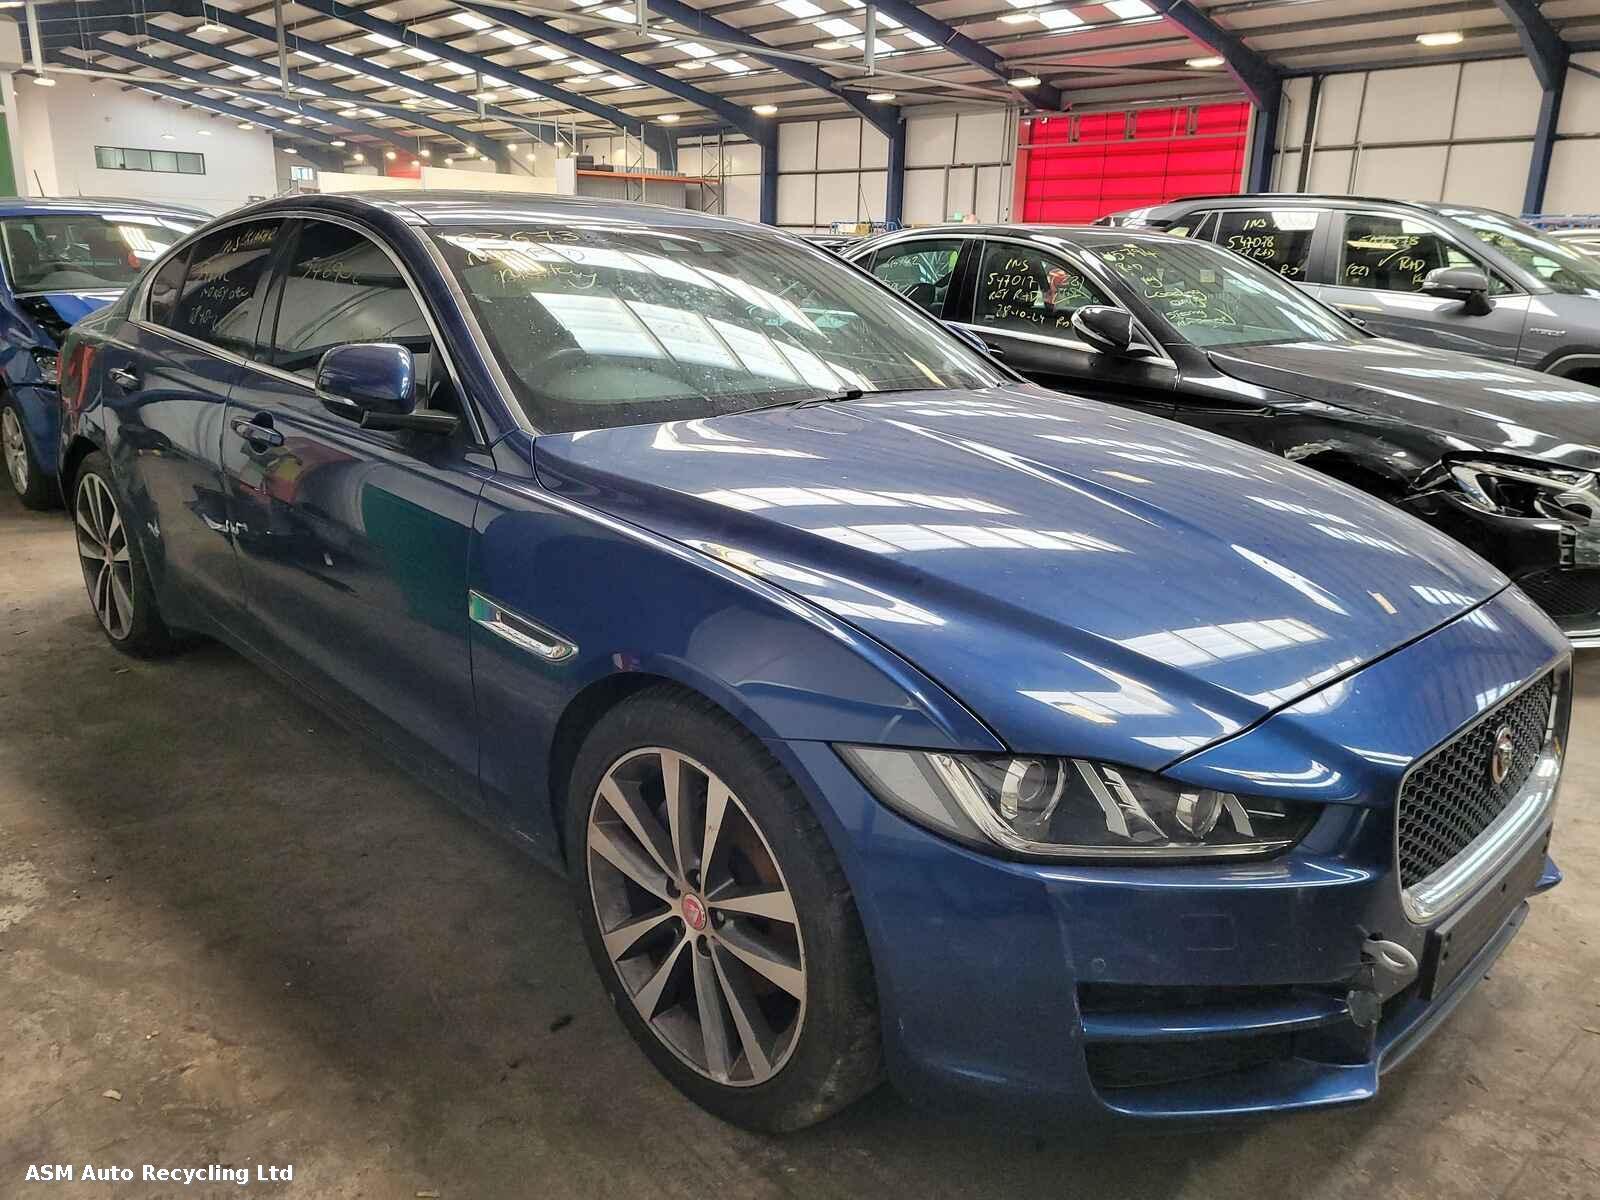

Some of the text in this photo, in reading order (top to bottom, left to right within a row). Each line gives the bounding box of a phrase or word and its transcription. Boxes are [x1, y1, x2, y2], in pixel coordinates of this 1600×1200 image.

[1243, 219, 1266, 231] INS
[1226, 235, 1275, 249] 547078
[1004, 257, 1030, 273] INS
